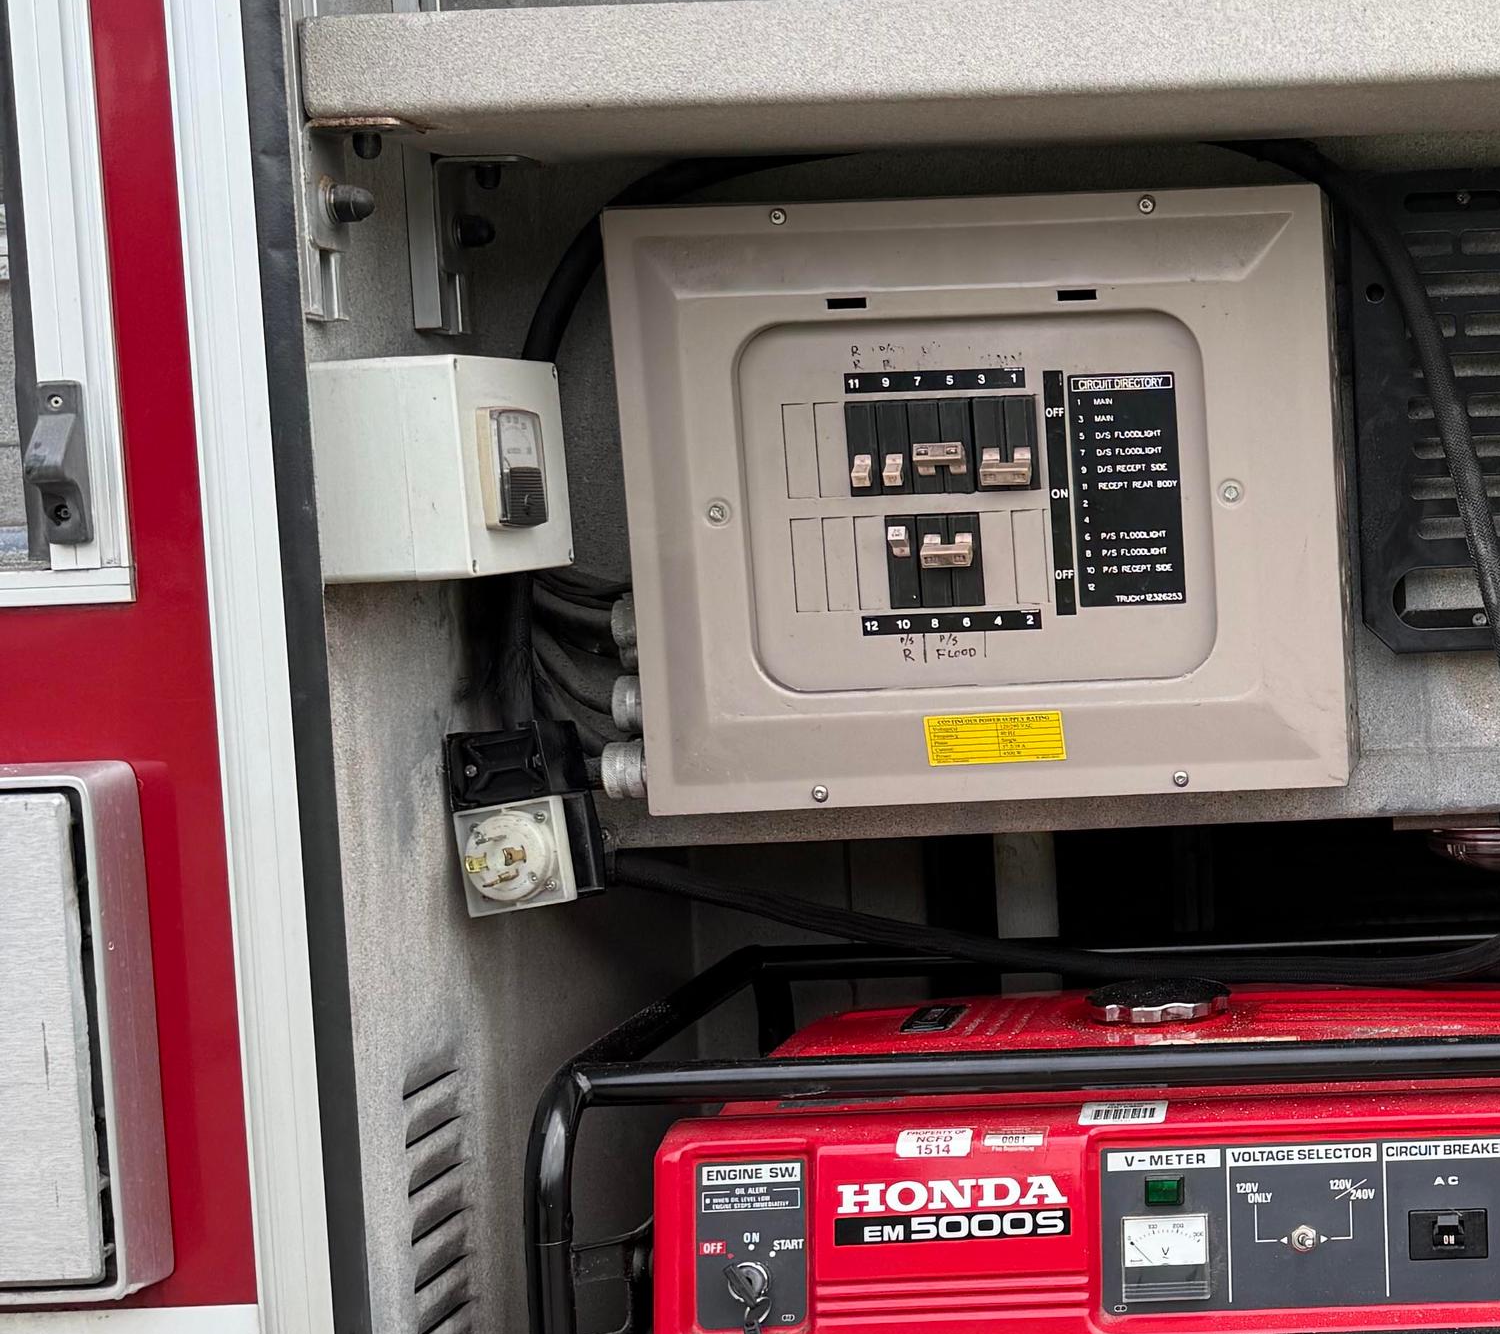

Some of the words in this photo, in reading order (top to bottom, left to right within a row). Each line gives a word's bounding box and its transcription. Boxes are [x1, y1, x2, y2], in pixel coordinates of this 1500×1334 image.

[848, 378, 860, 389] 11
[881, 377, 890, 388] 9
[913, 375, 922, 386] 7
[945, 375, 954, 386] 5
[977, 374, 986, 385] 3
[1010, 373, 1017, 384] 1
[1078, 379, 1112, 390] CIRCUIT
[1114, 378, 1164, 389] DIRECTORY
[1045, 407, 1064, 418] OFF
[1078, 415, 1084, 423] 3
[1079, 432, 1085, 440] 5
[1095, 431, 1111, 439] D/S
[1114, 429, 1161, 439] FLOODLIGHT
[1096, 448, 1112, 456] D/S
[1115, 446, 1162, 455] FLOODLIGHT
[1081, 466, 1087, 474] 9
[1097, 465, 1113, 473] D/S
[1116, 463, 1146, 472] RECEPT
[1150, 463, 1168, 471] SIDE
[1098, 481, 1128, 490] RECEPT
[1132, 480, 1154, 488] REAR
[1157, 479, 1178, 488] BODY
[1051, 488, 1069, 499] ON
[1082, 499, 1089, 508] 2
[1084, 516, 1090, 524] 4
[1100, 531, 1117, 540] P/S
[1119, 530, 1167, 539] FLOODLIGHT
[1085, 549, 1092, 557] 8
[1101, 548, 1118, 557] P/S
[1120, 547, 1168, 556] FLOODLIGHT
[1086, 566, 1096, 574] 10
[1102, 565, 1119, 573] P/S
[1121, 564, 1151, 573] RECEPT
[1155, 563, 1173, 572] SIDE
[1055, 569, 1075, 580] OFF
[1087, 583, 1096, 591] 12
[864, 620, 879, 631] 12
[896, 619, 911, 630] 10
[931, 618, 940, 629] 8
[962, 617, 971, 628] 6
[994, 616, 1003, 626] 4
[1026, 615, 1034, 625] 2
[903, 648, 915, 662] R
[936, 647, 977, 660] FLOOD
[916, 1135, 953, 1143] NCFD
[916, 1144, 951, 1155] 1514
[1231, 1147, 1295, 1163] VOLTAGE
[1298, 1146, 1372, 1160] SELECTOR
[1386, 1145, 1439, 1157] CIRCUIT
[706, 1168, 763, 1181] ENGINE
[769, 1166, 797, 1178] SW.
[735, 1187, 746, 1195] OIL
[748, 1186, 768, 1194] ALERT
[1235, 1183, 1259, 1193] 120V
[836, 1175, 1068, 1214] HONDA
[1247, 1192, 1273, 1203] ONLY
[743, 1232, 760, 1243] ON
[1443, 1234, 1455, 1245] ON
[703, 1242, 723, 1254] OFF
[773, 1238, 805, 1251] START
[1161, 1246, 1170, 1256] V
